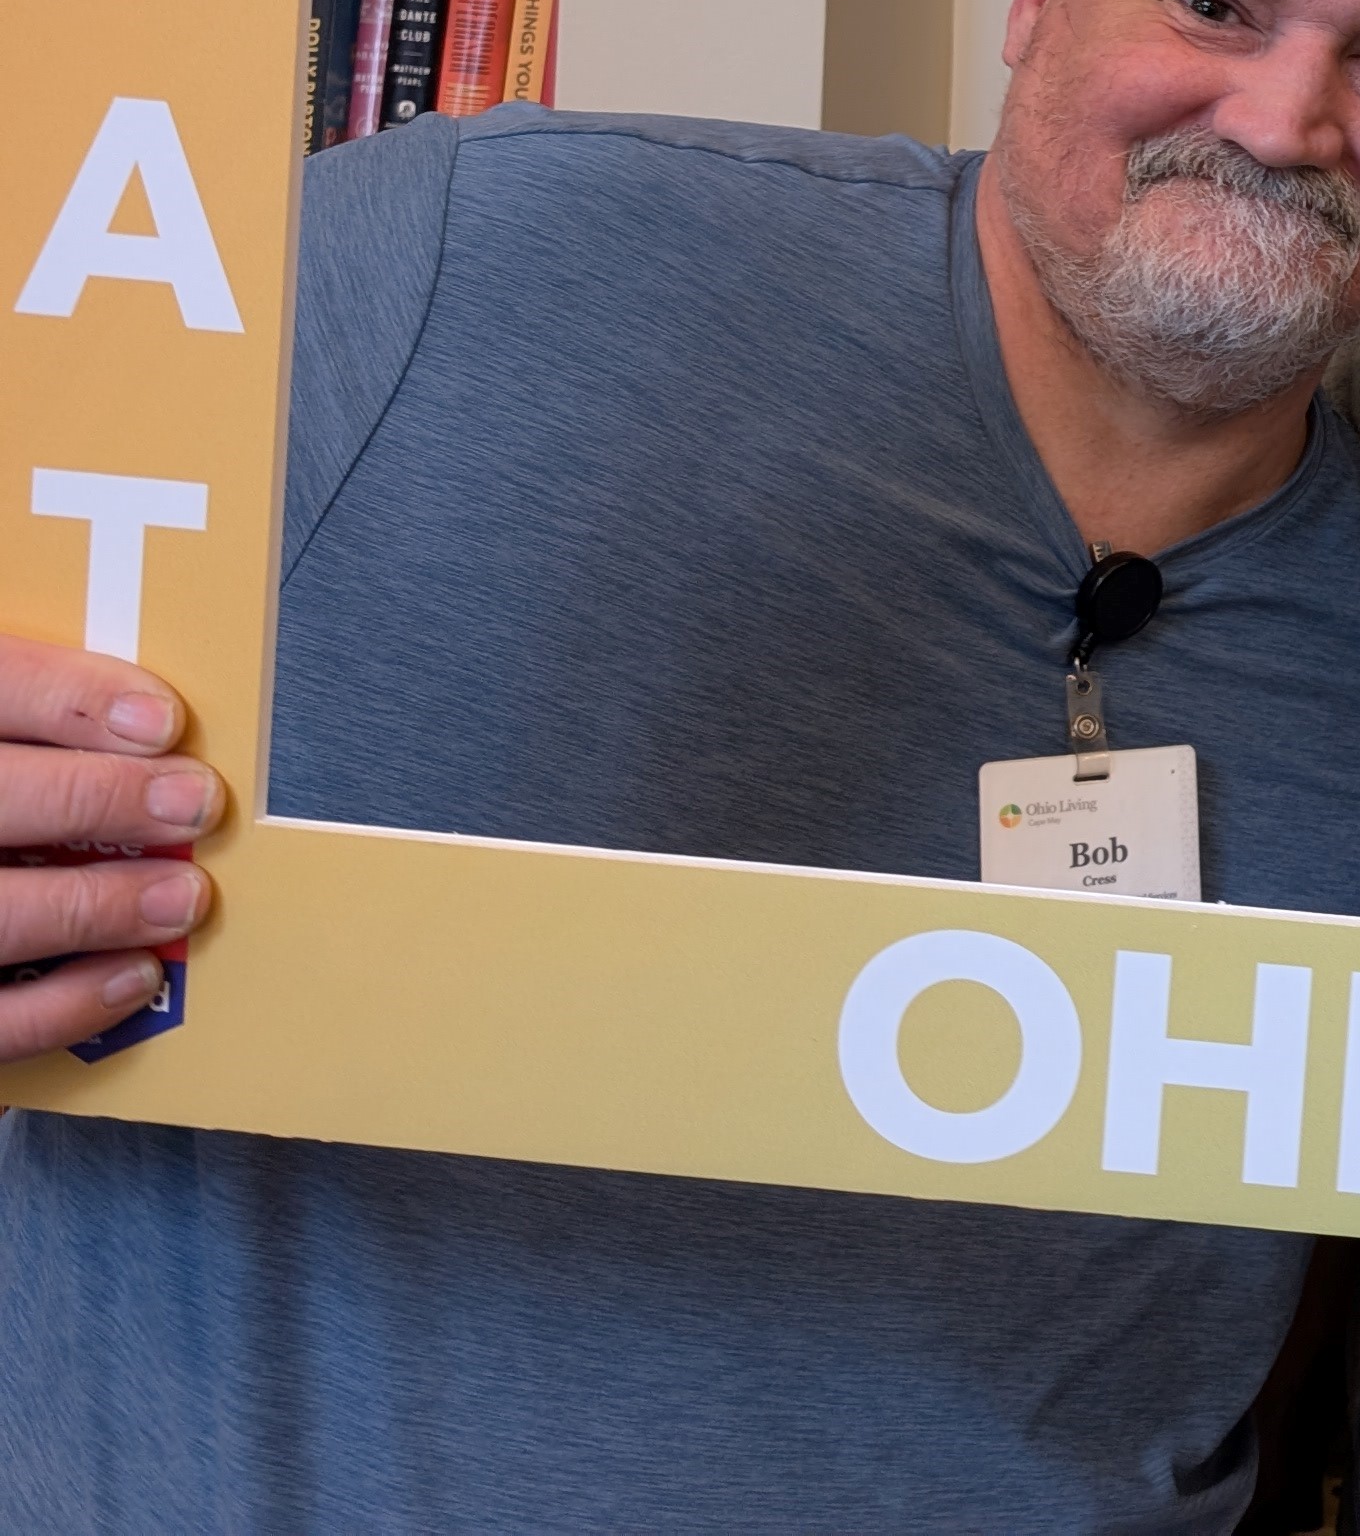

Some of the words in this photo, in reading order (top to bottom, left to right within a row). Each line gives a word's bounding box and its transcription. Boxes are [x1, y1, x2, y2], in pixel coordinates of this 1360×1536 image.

[400, 10, 436, 24] DANTE
[400, 30, 430, 42] CLUB
[1026, 802, 1056, 816] Ohio
[1060, 799, 1097, 813] Living
[1070, 838, 1128, 868] Bob
[1083, 874, 1116, 886] Cress
